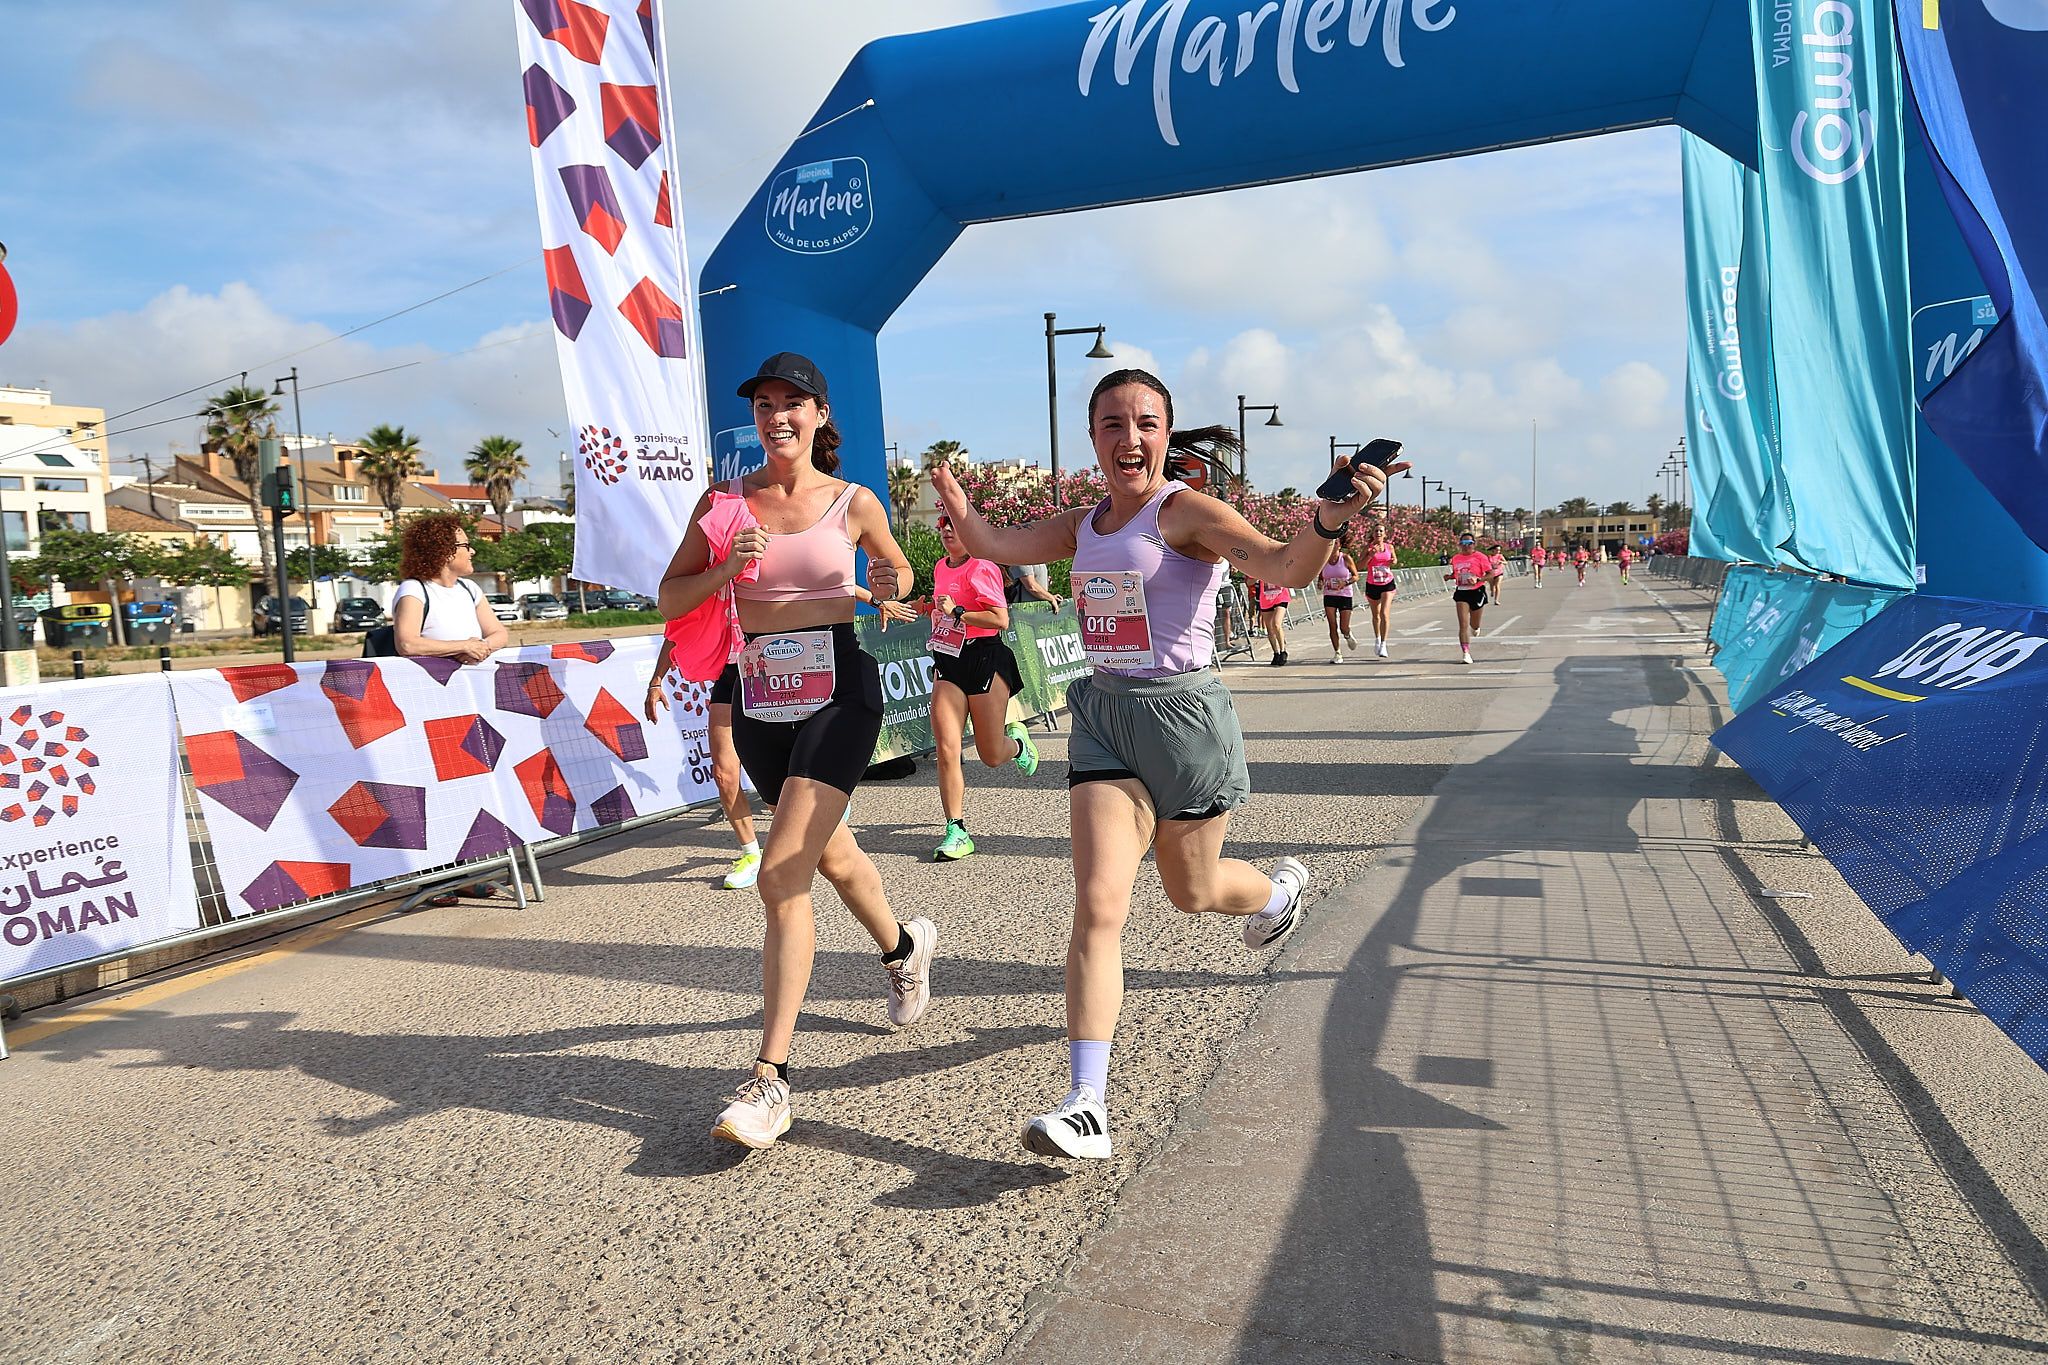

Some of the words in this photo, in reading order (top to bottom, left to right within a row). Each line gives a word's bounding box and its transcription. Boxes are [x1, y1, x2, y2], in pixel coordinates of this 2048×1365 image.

[776, 230, 794, 245] HIJA
[796, 239, 809, 248] DE
[812, 239, 830, 248] LOS
[832, 225, 859, 245] ALPES
[1086, 616, 1117, 633] 016
[765, 646, 801, 656] ASTURIANA
[1110, 656, 1141, 665] Santander
[769, 673, 803, 691] 016
[754, 710, 784, 719] OYSHO
[917, 703, 928, 718] de
[681, 725, 708, 741] Exper
[691, 764, 714, 785] OM
[0, 835, 119, 871] xperience
[3, 891, 139, 947] OMAN
